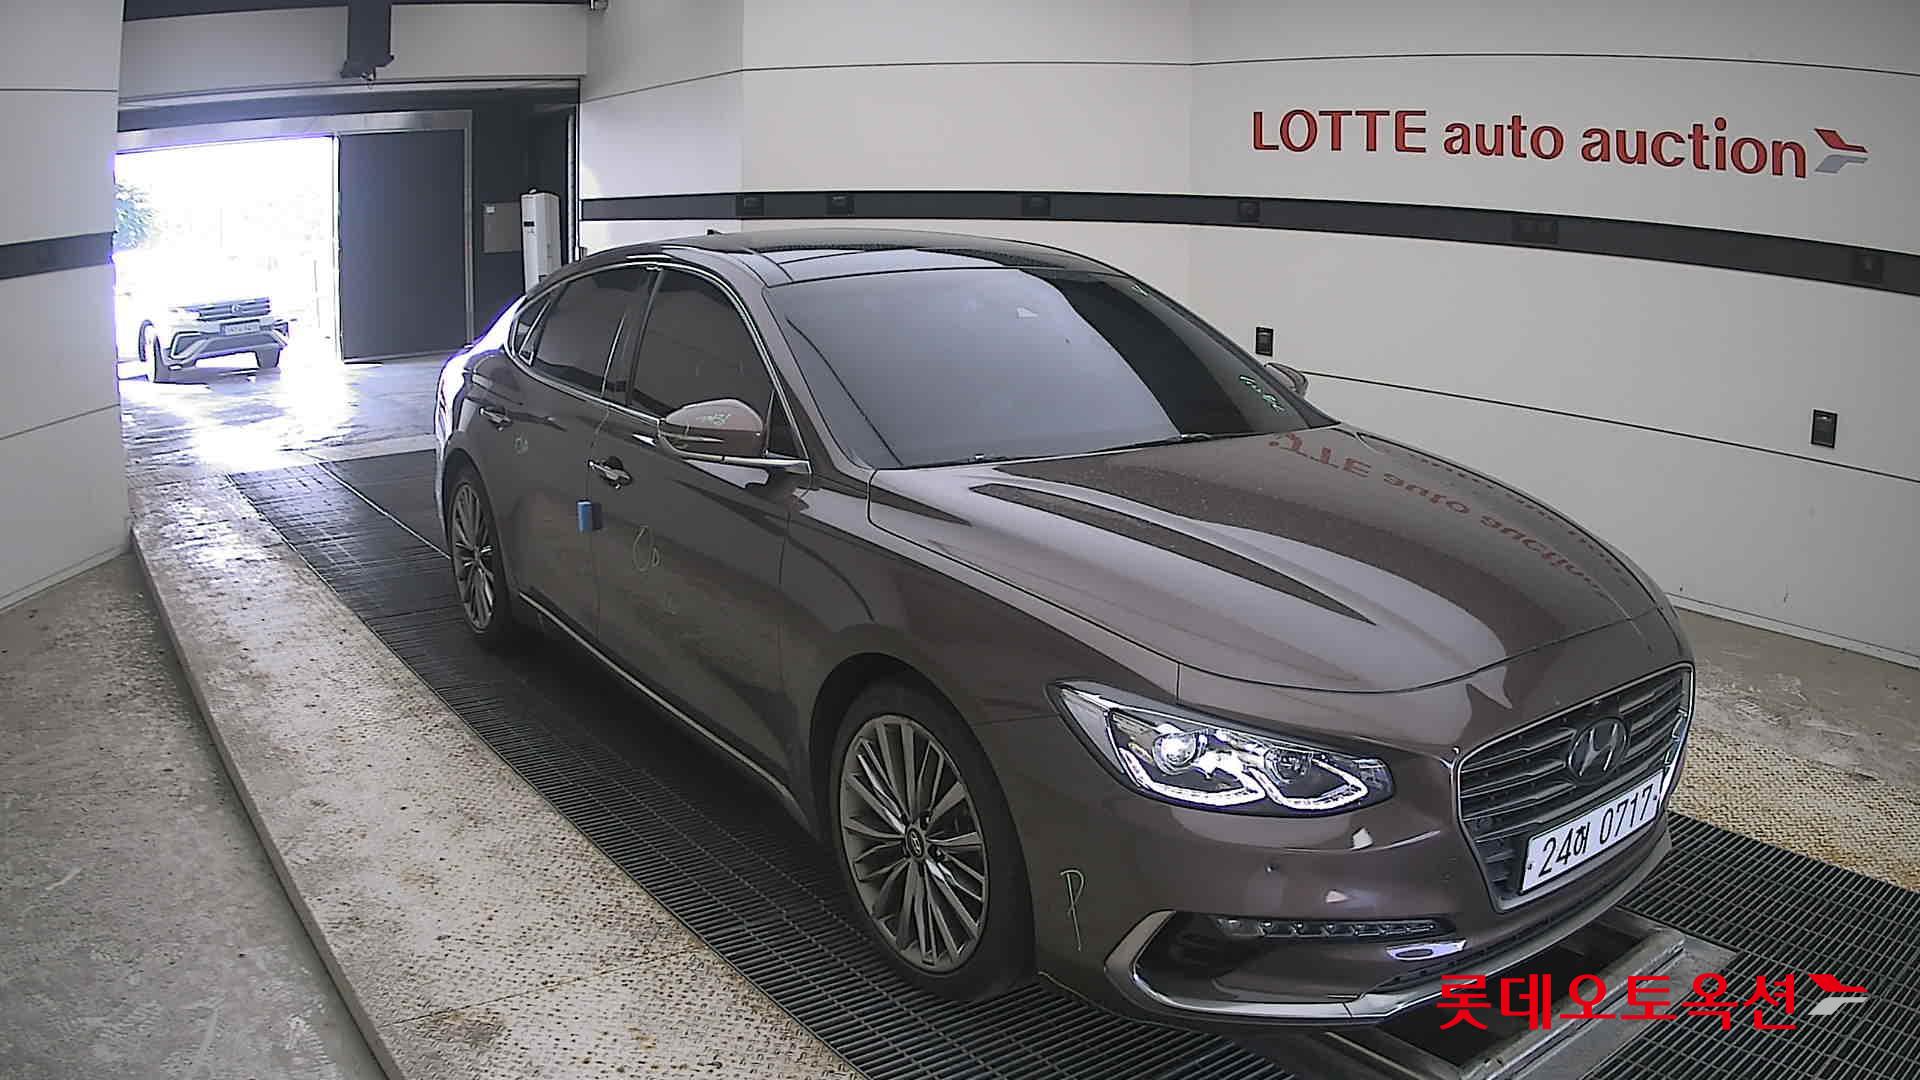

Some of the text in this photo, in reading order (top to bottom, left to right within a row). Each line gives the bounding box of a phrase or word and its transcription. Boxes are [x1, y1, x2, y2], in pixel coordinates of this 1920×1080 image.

[1253, 110, 1807, 179] LOTTE auto auction
[1538, 783, 1654, 878] 24허 0717
